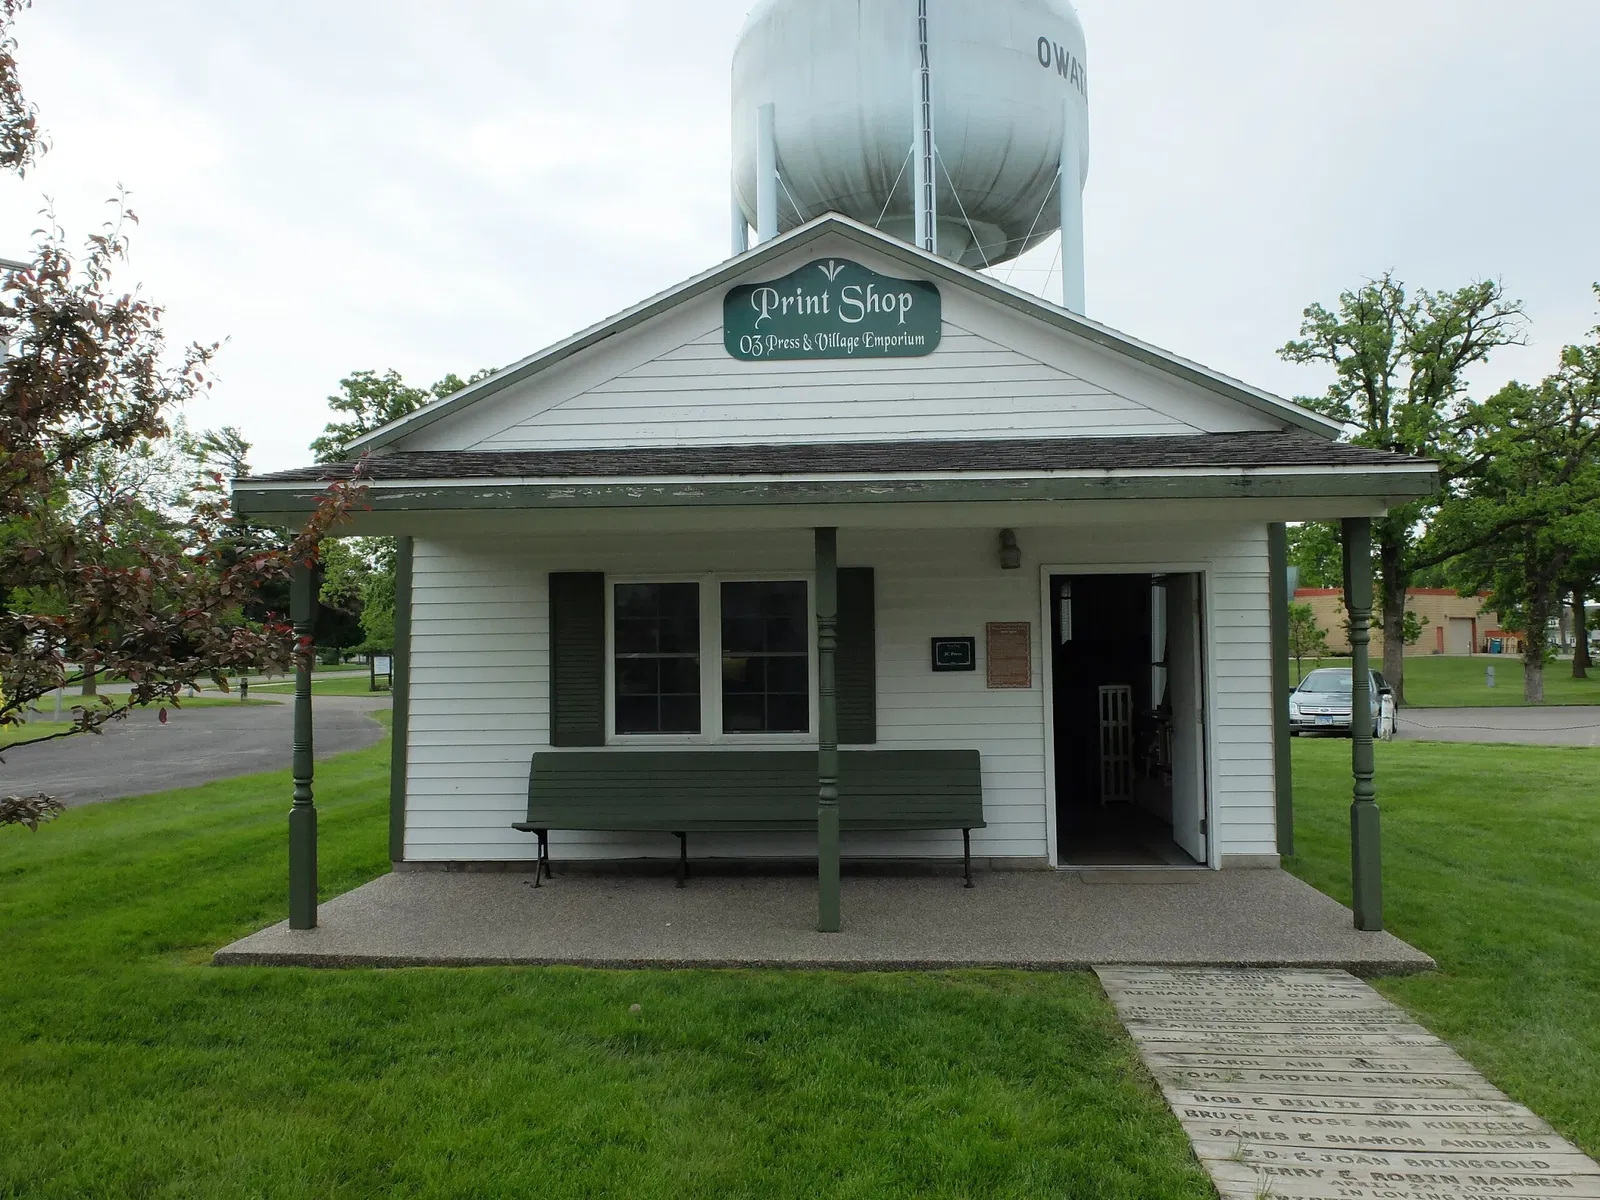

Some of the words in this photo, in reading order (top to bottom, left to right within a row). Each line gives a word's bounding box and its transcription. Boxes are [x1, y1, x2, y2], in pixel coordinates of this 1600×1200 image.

[750, 287, 830, 330] Print
[838, 284, 913, 325] Shop
[765, 334, 800, 356] Press
[802, 335, 813, 351] &
[814, 332, 859, 354] Village
[862, 331, 925, 352] Emporium
[1177, 1071, 1220, 1079] TOM
[1258, 1074, 1353, 1082] ARDELLA
[1193, 1094, 1242, 1104] BOB
[1251, 1097, 1270, 1106] &
[1279, 1099, 1366, 1109] BILLIE
[1372, 1101, 1498, 1113] SPRINGER
[1183, 1109, 1259, 1122] BRUCE
[1268, 1115, 1287, 1124] &
[1291, 1116, 1357, 1127] ROSE
[1364, 1119, 1412, 1129] ANN
[1208, 1128, 1290, 1141] JAMES
[1298, 1133, 1316, 1142] &
[1325, 1134, 1426, 1146] SHARON
[1440, 1138, 1552, 1150] ANDREWS
[1293, 1151, 1313, 1162] &
[1320, 1153, 1391, 1166] JOAN
[1403, 1158, 1551, 1169] BRINGGOLD
[1245, 1164, 1325, 1178] TERRY
[1337, 1170, 1358, 1181] &
[1369, 1172, 1461, 1184] ROBIN
[1468, 1175, 1574, 1188] HANSEN
[1328, 1180, 1397, 1189] APRIL
[1336, 1188, 1364, 1197] IN
[1371, 1190, 1455, 1200] LOVING
